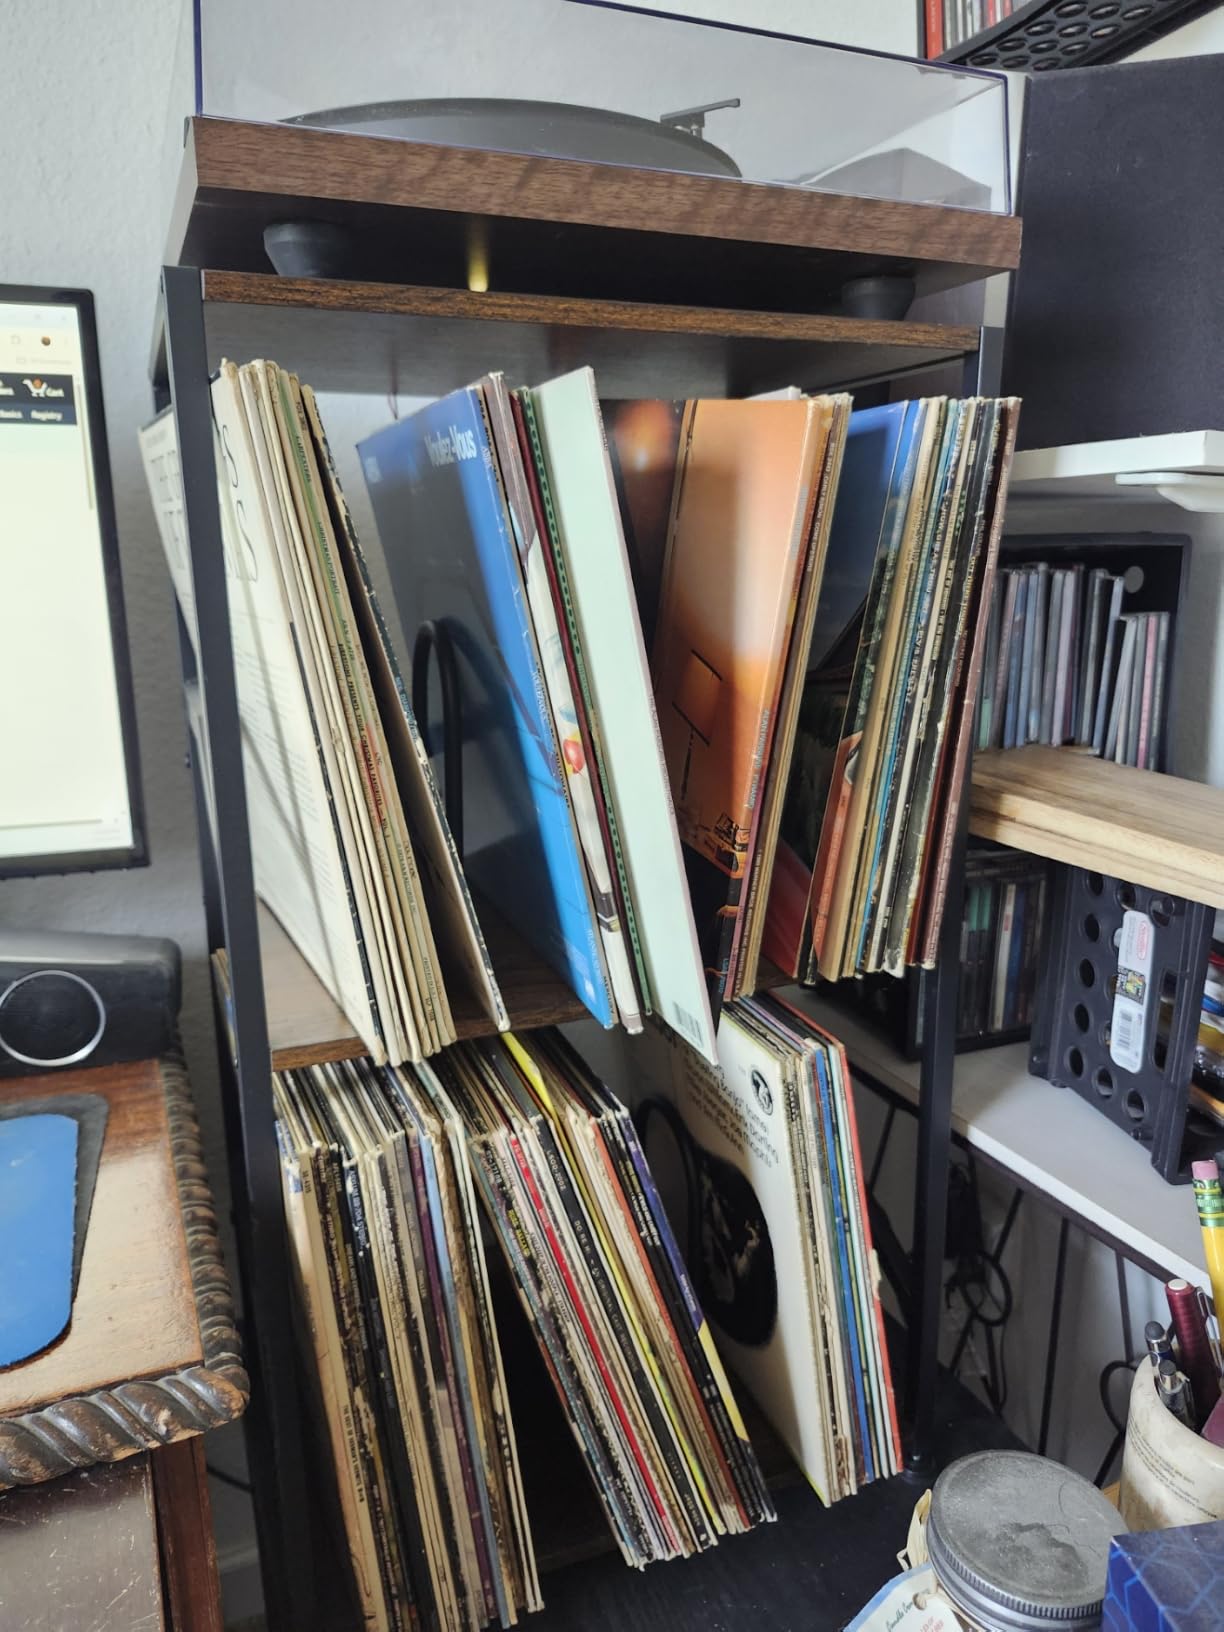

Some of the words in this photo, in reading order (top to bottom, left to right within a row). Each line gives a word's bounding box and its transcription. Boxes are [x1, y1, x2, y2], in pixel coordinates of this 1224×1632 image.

[295, 434, 312, 483] CARPENTERS
[821, 475, 829, 495] CARLY
[816, 496, 825, 518] SIMON
[812, 521, 820, 540] COME
[316, 520, 331, 561] CHRISTMAS
[326, 561, 340, 595] PORTRAIT
[806, 542, 816, 572] UPSTAIRS
[931, 533, 942, 562] GREAT
[926, 567, 936, 593] THOU
[337, 642, 351, 677] FIRESTONE
[347, 680, 359, 711] PRESENTS
[355, 713, 365, 731] YOUR
[360, 733, 374, 770] CHRISTMAS
[370, 773, 383, 806] FAVORITES
[759, 709, 770, 732] ALAN
[747, 774, 758, 808] PYRAMID
[743, 908, 752, 935] RECORDS
[737, 947, 746, 970] PRINTED
[545, 1149, 566, 1191] LSOD-2002
[573, 1219, 583, 1232] DO
[579, 1232, 587, 1243] RE
[341, 1403, 349, 1414] THE
[343, 1415, 351, 1428] BEST
[347, 1435, 358, 1463] HERMAN'S
